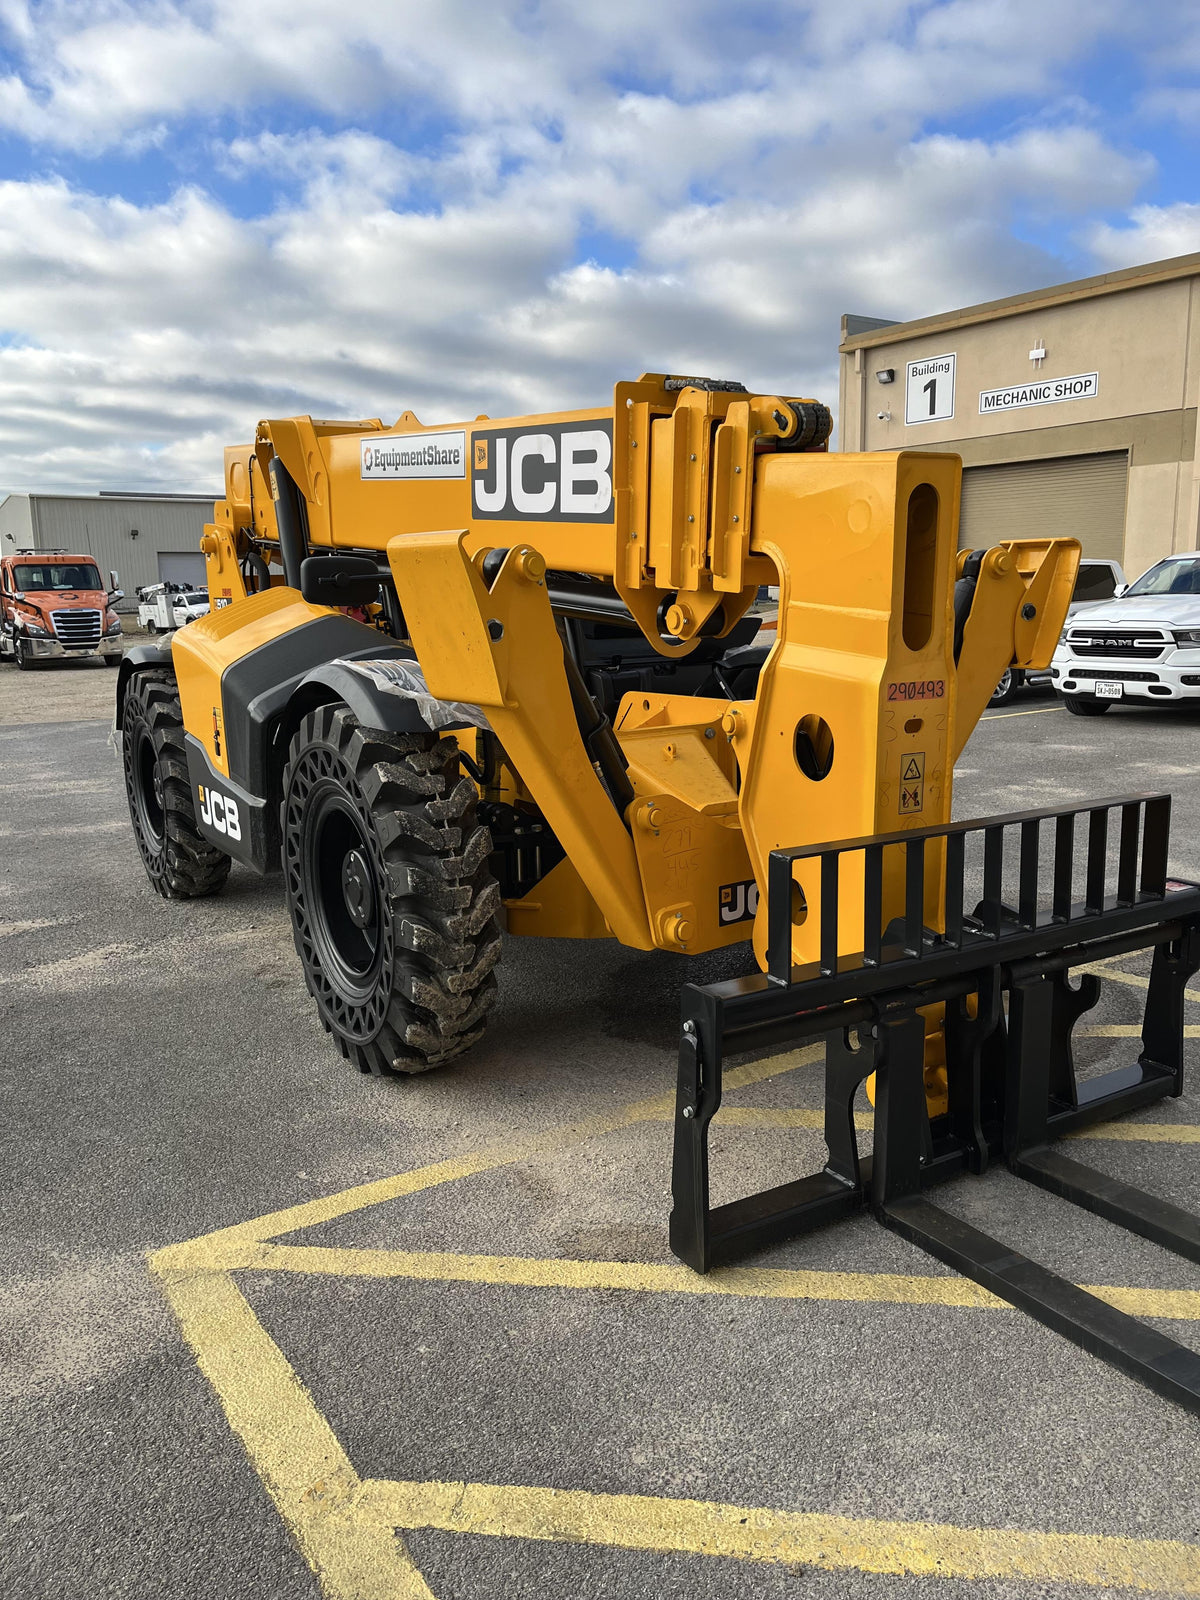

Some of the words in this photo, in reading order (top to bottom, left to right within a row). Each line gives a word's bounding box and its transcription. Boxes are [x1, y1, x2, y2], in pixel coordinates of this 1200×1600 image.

[911, 362, 950, 377] Building
[923, 378, 937, 416] 1
[984, 386, 1050, 408] MECHANIC
[1054, 379, 1092, 397] SHOP
[374, 445, 460, 471] EquipmentShare
[475, 430, 612, 514] JCB
[888, 680, 944, 700] 290493
[201, 786, 242, 841] JCB
